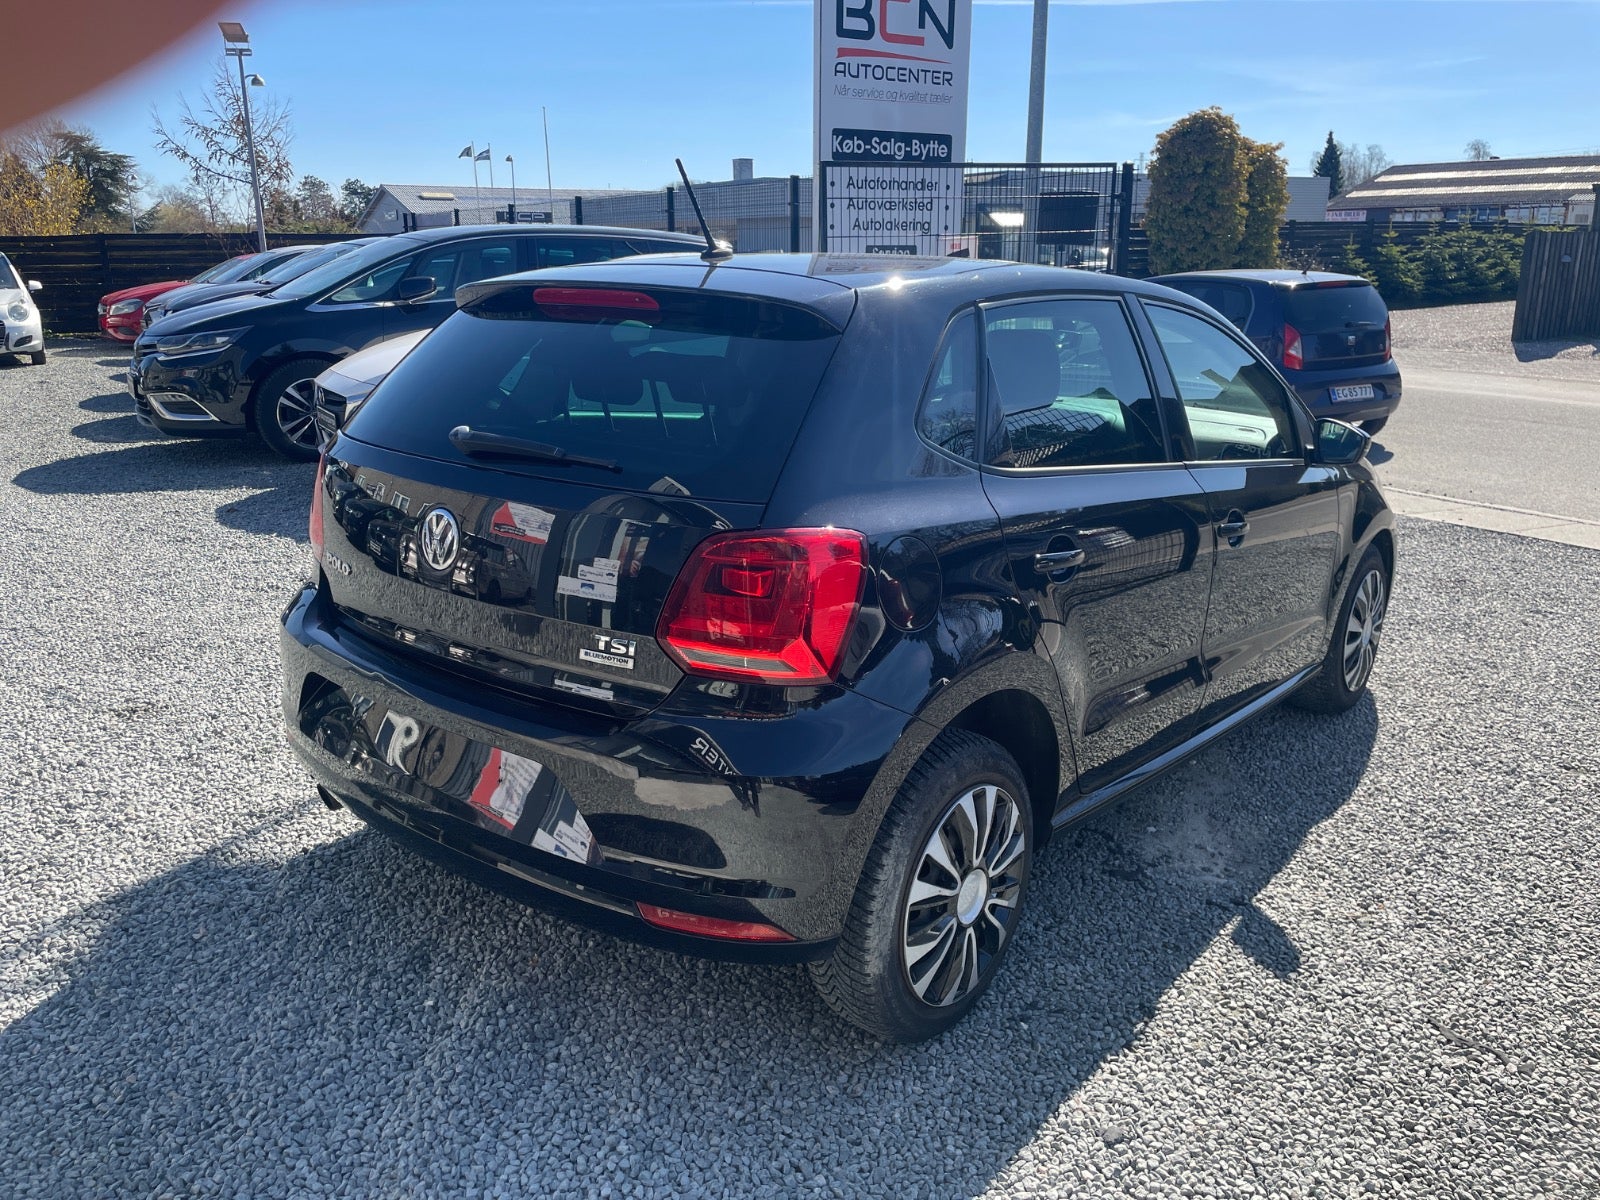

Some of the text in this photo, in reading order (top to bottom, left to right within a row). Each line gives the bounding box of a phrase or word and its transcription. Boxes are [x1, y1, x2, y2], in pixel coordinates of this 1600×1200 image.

[834, 61, 953, 87] AUTOCENTER
[834, 84, 953, 104] Når service og kvalitet tæller
[832, 135, 948, 160] Køb-Salg-Bytte
[846, 176, 938, 192] Autoforhandler
[846, 198, 933, 212] Autoværksted
[852, 218, 931, 235] Autolakering
[326, 552, 353, 576] POLO
[594, 634, 637, 657] TSI
[583, 650, 629, 665] BLUEMOTION
